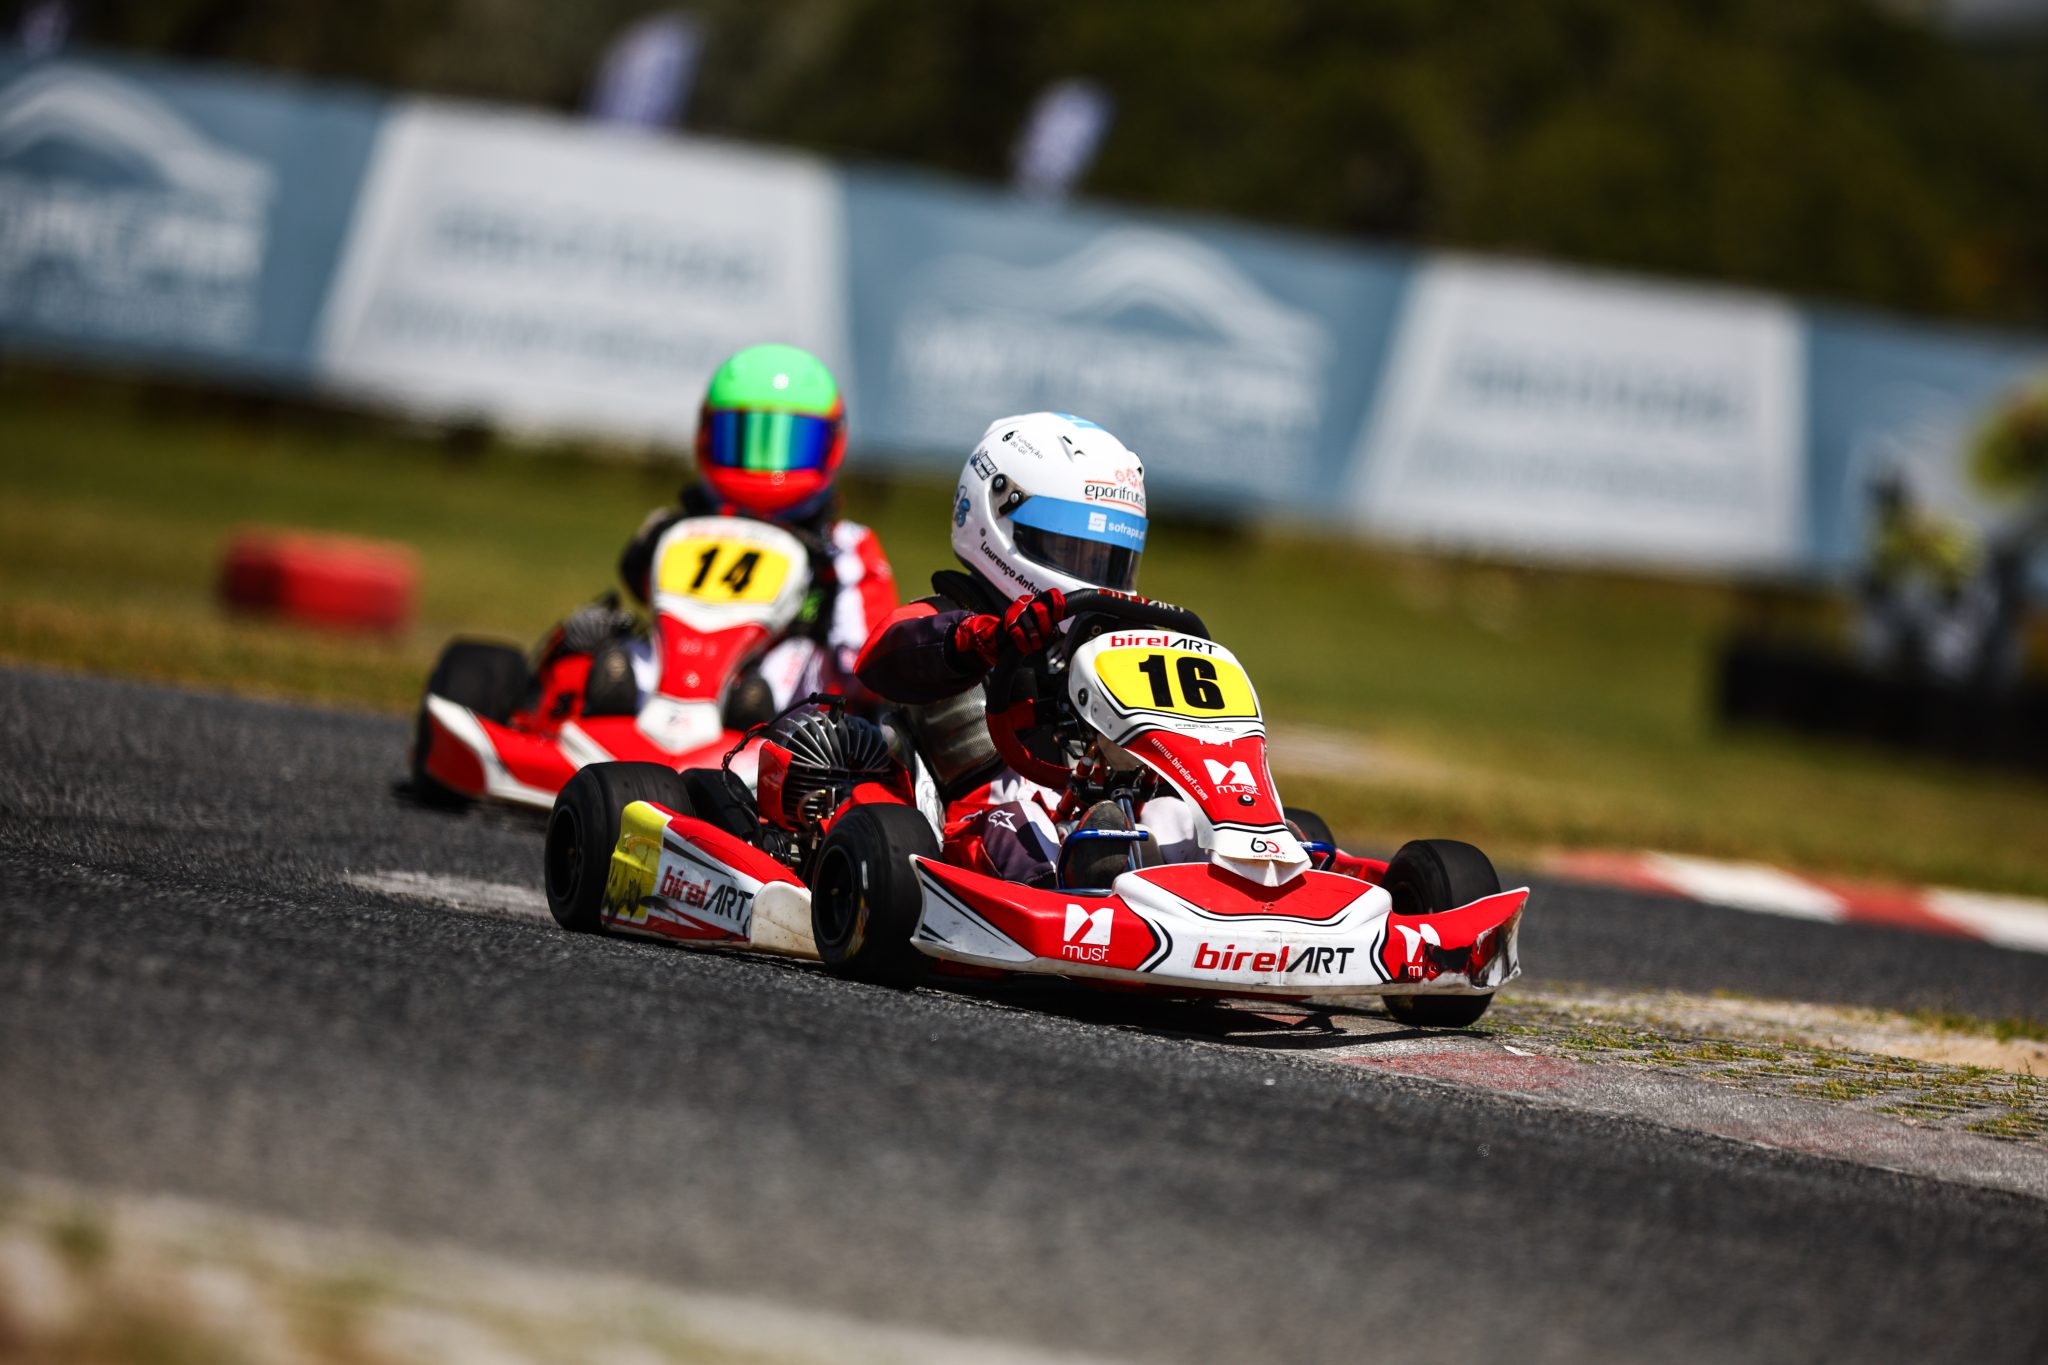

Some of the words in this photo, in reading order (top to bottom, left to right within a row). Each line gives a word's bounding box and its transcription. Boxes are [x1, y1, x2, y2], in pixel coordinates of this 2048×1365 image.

[688, 545, 761, 594] 14
[980, 541, 1016, 578] Lourenço
[1110, 634, 1218, 654] birelART
[1138, 654, 1225, 710] 16
[1151, 738, 1209, 801] www.birelart.com
[1216, 785, 1261, 796] must
[660, 864, 754, 921] birelART
[1193, 942, 1355, 974] birelART
